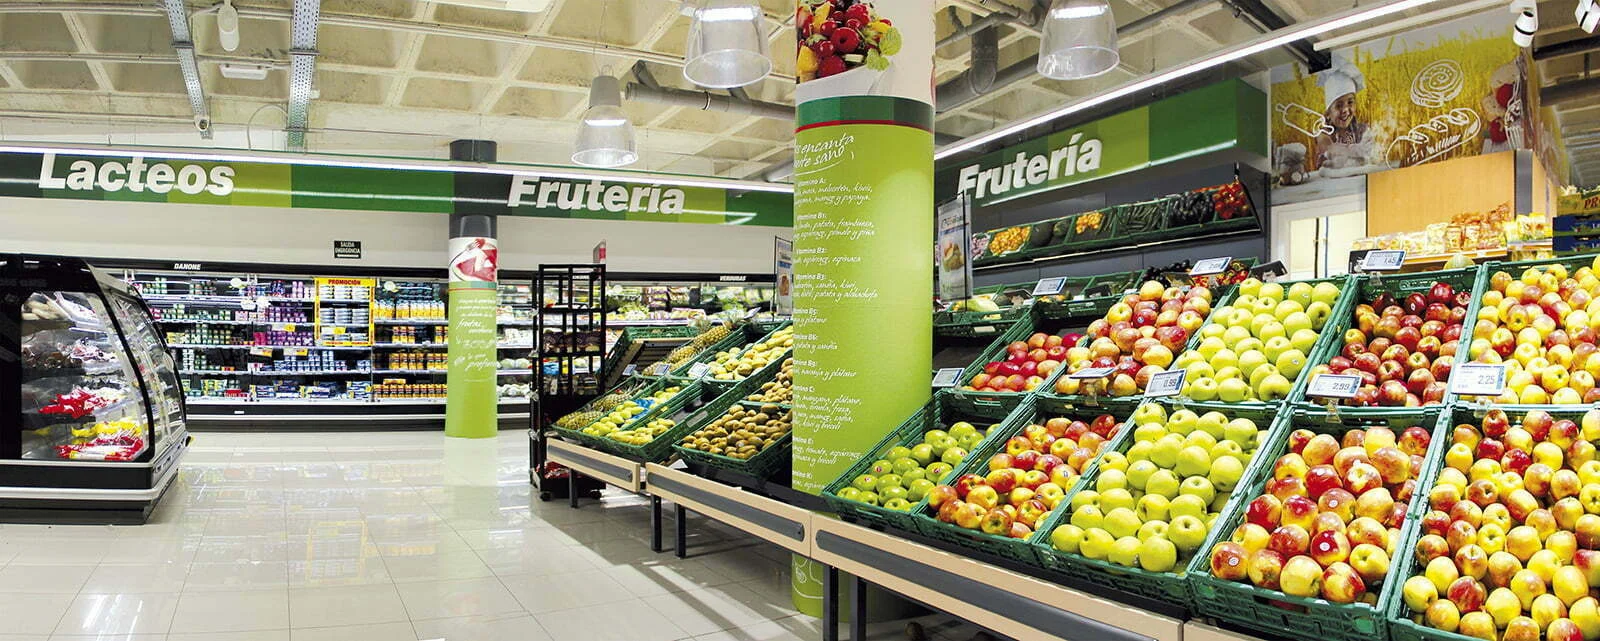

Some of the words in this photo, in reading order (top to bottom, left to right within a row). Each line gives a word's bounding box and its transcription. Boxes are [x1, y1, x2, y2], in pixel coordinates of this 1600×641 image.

[801, 132, 854, 154] encanta
[813, 145, 845, 165] sano
[957, 132, 1102, 199] Frutería
